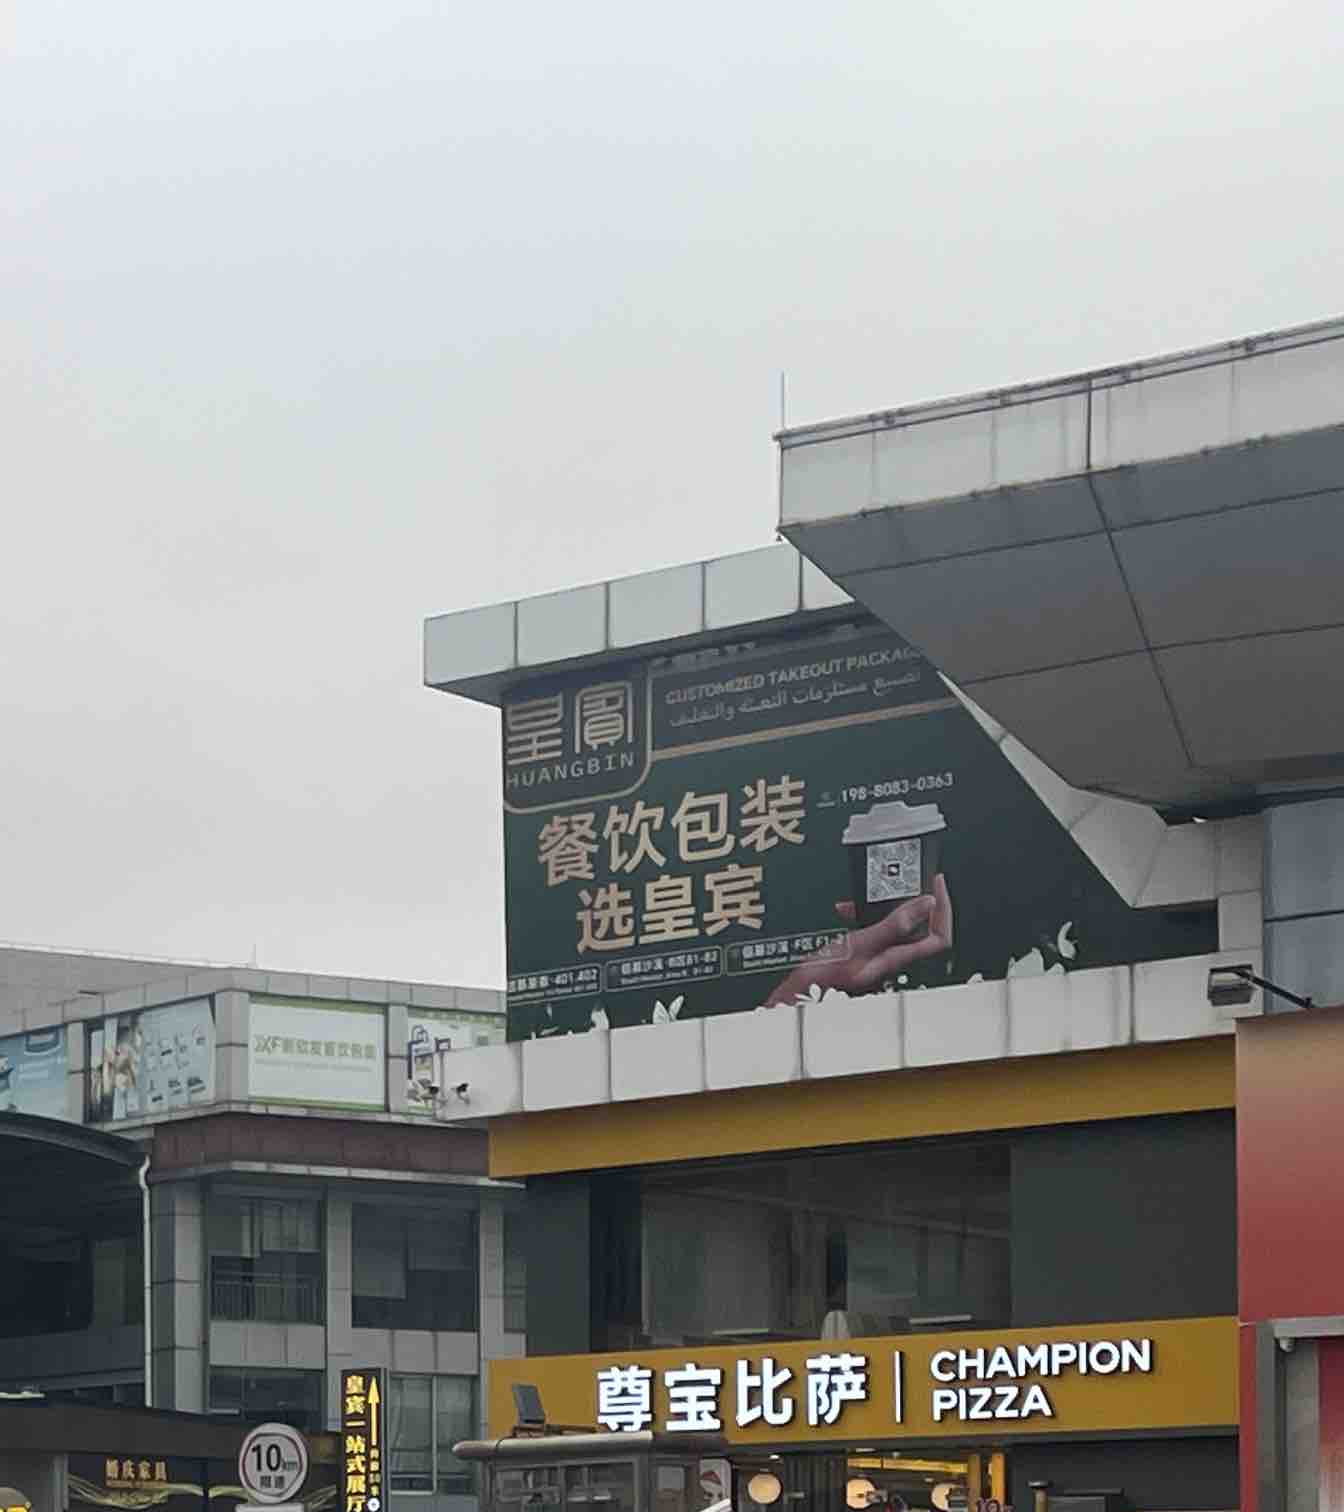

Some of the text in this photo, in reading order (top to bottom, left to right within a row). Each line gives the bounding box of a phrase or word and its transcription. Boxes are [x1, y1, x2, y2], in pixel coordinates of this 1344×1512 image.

[665, 673, 765, 704] CUSTOMIZED
[768, 659, 842, 685] TAKEOUT
[507, 751, 634, 787] HUANGBIN
[538, 775, 806, 888] 餐饮包装
[576, 864, 766, 955] 选皇宾
[930, 1337, 1153, 1382] CHAMPION
[596, 1353, 868, 1433] 尊宝比萨
[932, 1384, 1054, 1421] PIZZA
